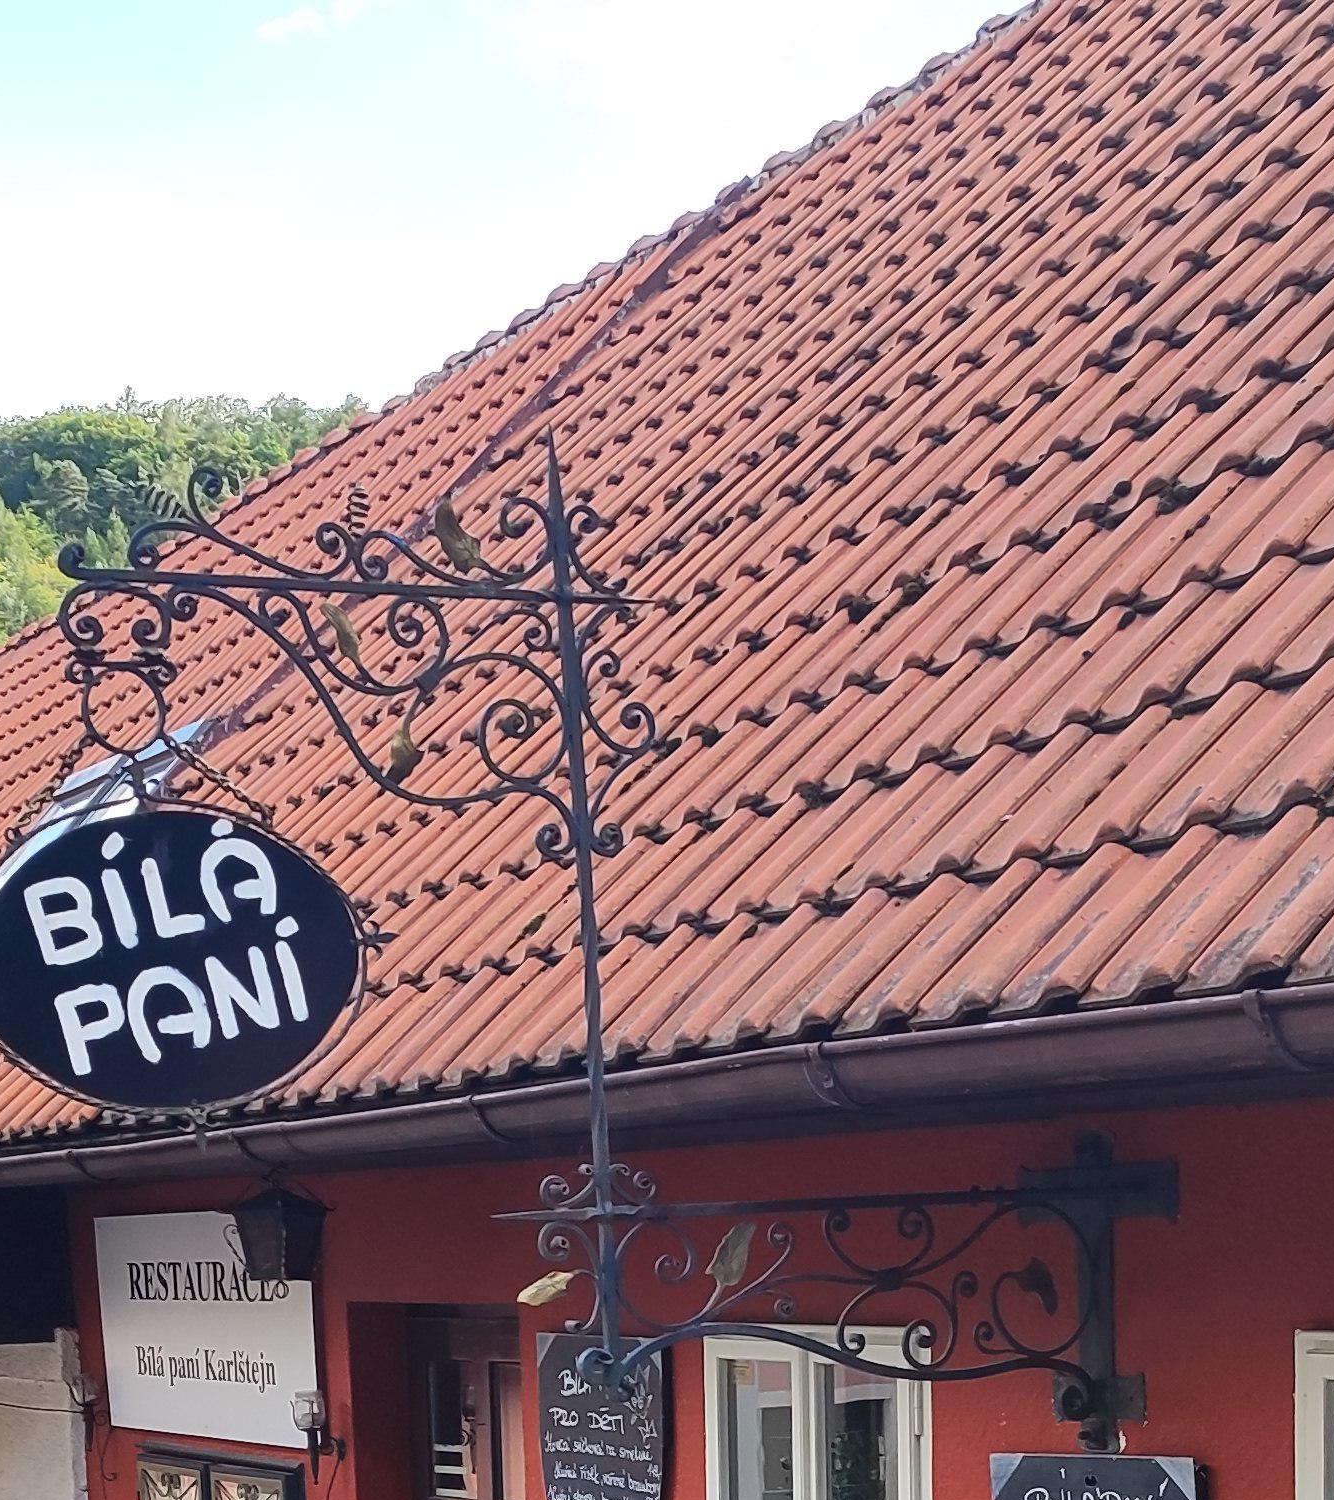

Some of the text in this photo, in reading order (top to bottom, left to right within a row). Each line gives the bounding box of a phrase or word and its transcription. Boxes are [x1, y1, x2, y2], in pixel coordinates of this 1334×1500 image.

[135, 1345, 276, 1393] Bílá paní Karlštejn
